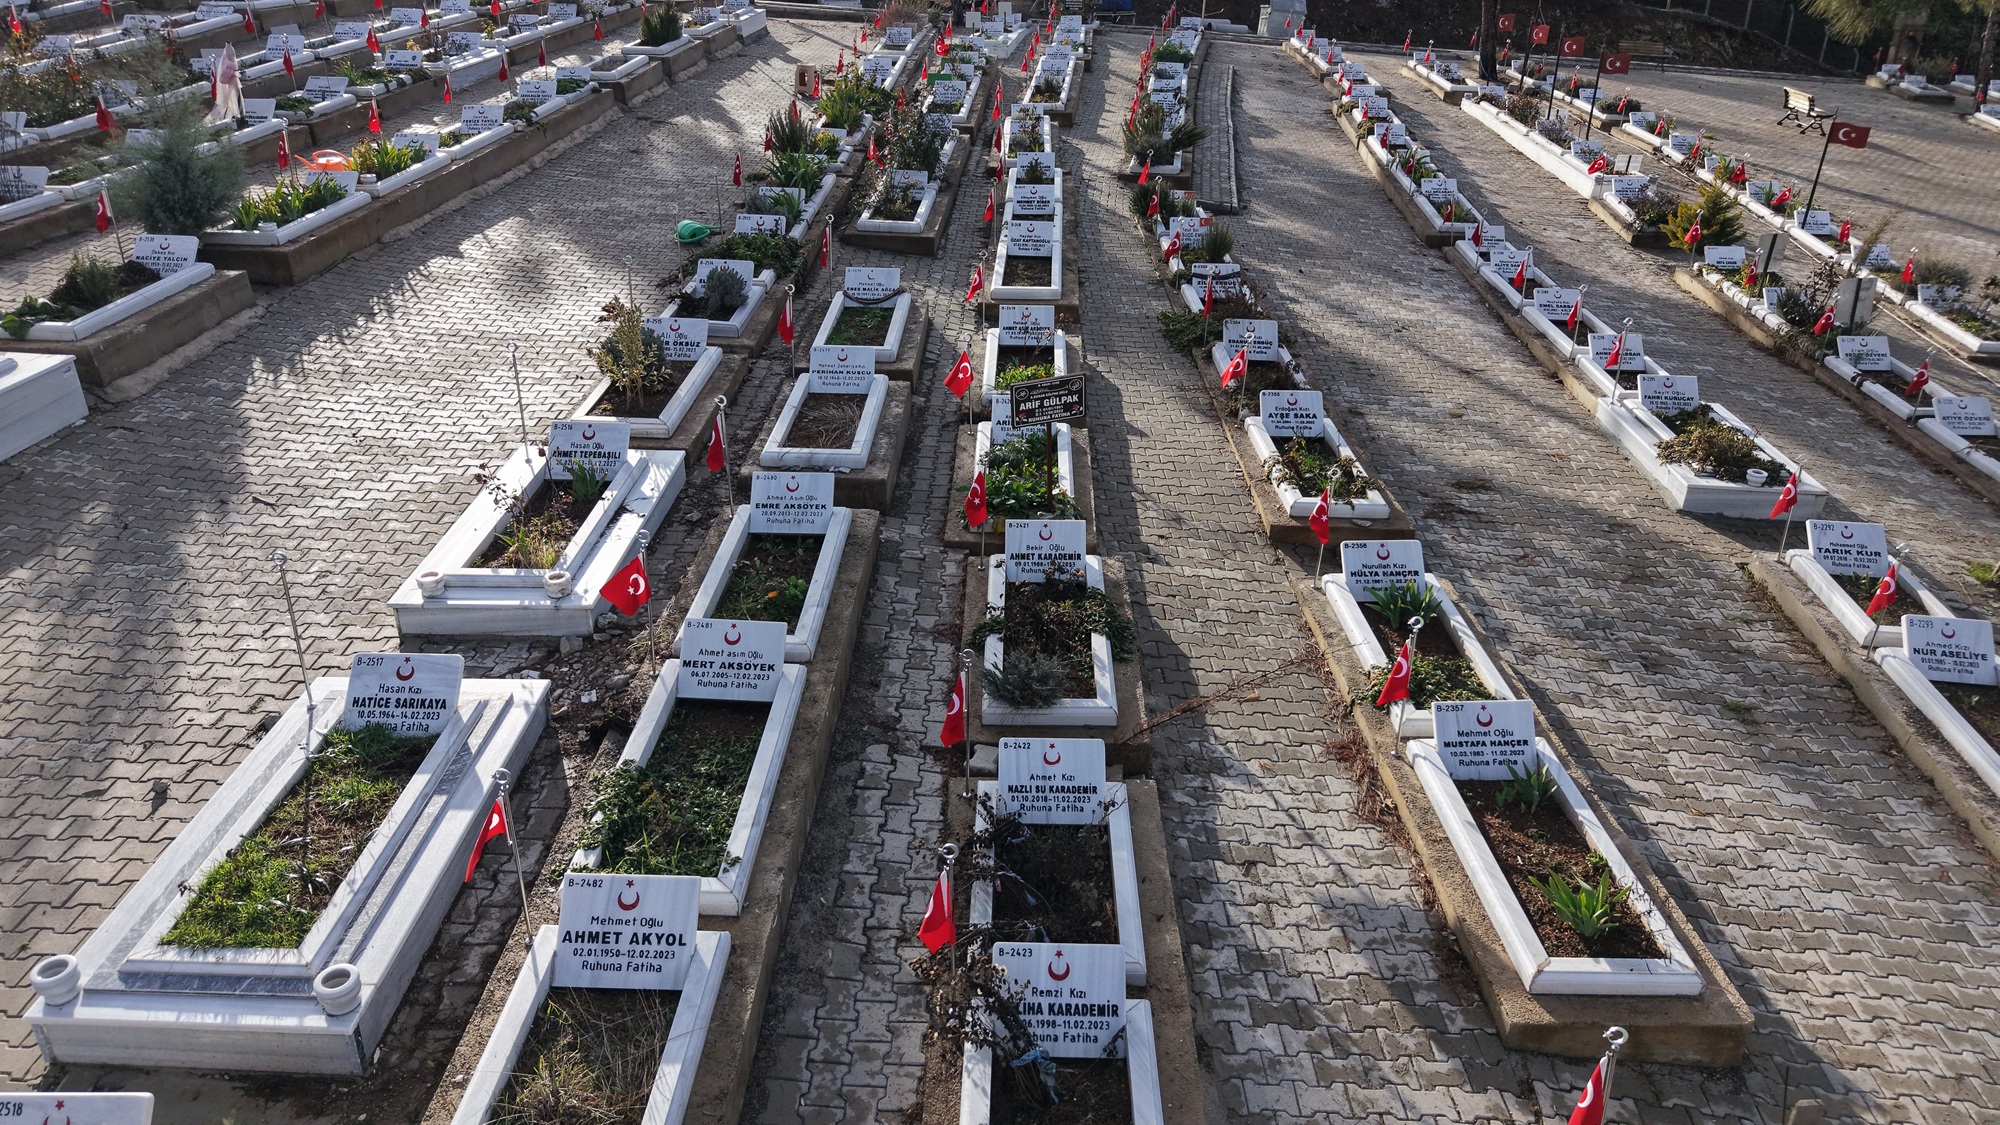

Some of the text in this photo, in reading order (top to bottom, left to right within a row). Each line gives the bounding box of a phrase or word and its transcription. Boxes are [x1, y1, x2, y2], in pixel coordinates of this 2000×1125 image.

[674, 332, 688, 340] Oğlu
[673, 339, 700, 347] ÖKSÜZ
[1020, 395, 1079, 410] ARİF GÜLPAK
[592, 442, 605, 450] Oğlu
[784, 502, 827, 510] AKSÖYEK
[1026, 543, 1065, 552] Bekir Oğlu
[1817, 547, 1882, 558] TARIK KUR
[1010, 551, 1082, 561] AHMET KARADEMİR
[1350, 569, 1381, 577] HÜLYA
[687, 620, 713, 629] B-2481
[1909, 619, 1933, 629] B-2293
[1926, 641, 1952, 650] Ahmed
[698, 648, 724, 658] Ahmet
[748, 650, 763, 659] Oğlu
[1913, 647, 1988, 661] NUR ASELİYE
[357, 657, 383, 667] B-2517
[683, 658, 776, 672] MERT AKSÖYEK
[691, 671, 770, 681] 06.07.2005-12.02.2023
[378, 683, 422, 694] Hasan Kızı
[697, 679, 758, 690] Ruhuna Fatiha
[352, 693, 447, 710] HATİCE SARIKAYA
[1436, 704, 1464, 713] B-2357
[357, 709, 440, 721] 10.05.1964-14.02.2023
[400, 721, 429, 733] Fatiha
[1457, 729, 1514, 738] Mehmet Oğlu
[1003, 741, 1031, 750] B-2422
[1443, 739, 1529, 749] MUSTAFA HANÇER
[1458, 758, 1520, 767] Ruhuna Fatiha
[1029, 772, 1076, 782] Ahmet Kızı
[1008, 781, 1098, 795] NAZLI SU KARADEMİR
[1010, 794, 1091, 805] 01.10.2018-11.02.2023
[1019, 803, 1084, 813] Ruhuna Fatiha
[568, 879, 603, 889] B-2482
[591, 916, 664, 929] Mehmet Oğlu
[562, 930, 687, 947] AHMET AKYOL
[572, 946, 676, 960] 02.01.1950-12.02.2023
[998, 948, 1033, 958] B-2423
[581, 960, 662, 973] Ruhuna Fatiha
[1031, 986, 1087, 999] Remzi Kızı
[1047, 998, 1119, 1018] KARADEMİR
[1063, 1030, 1099, 1044] Fatiha
